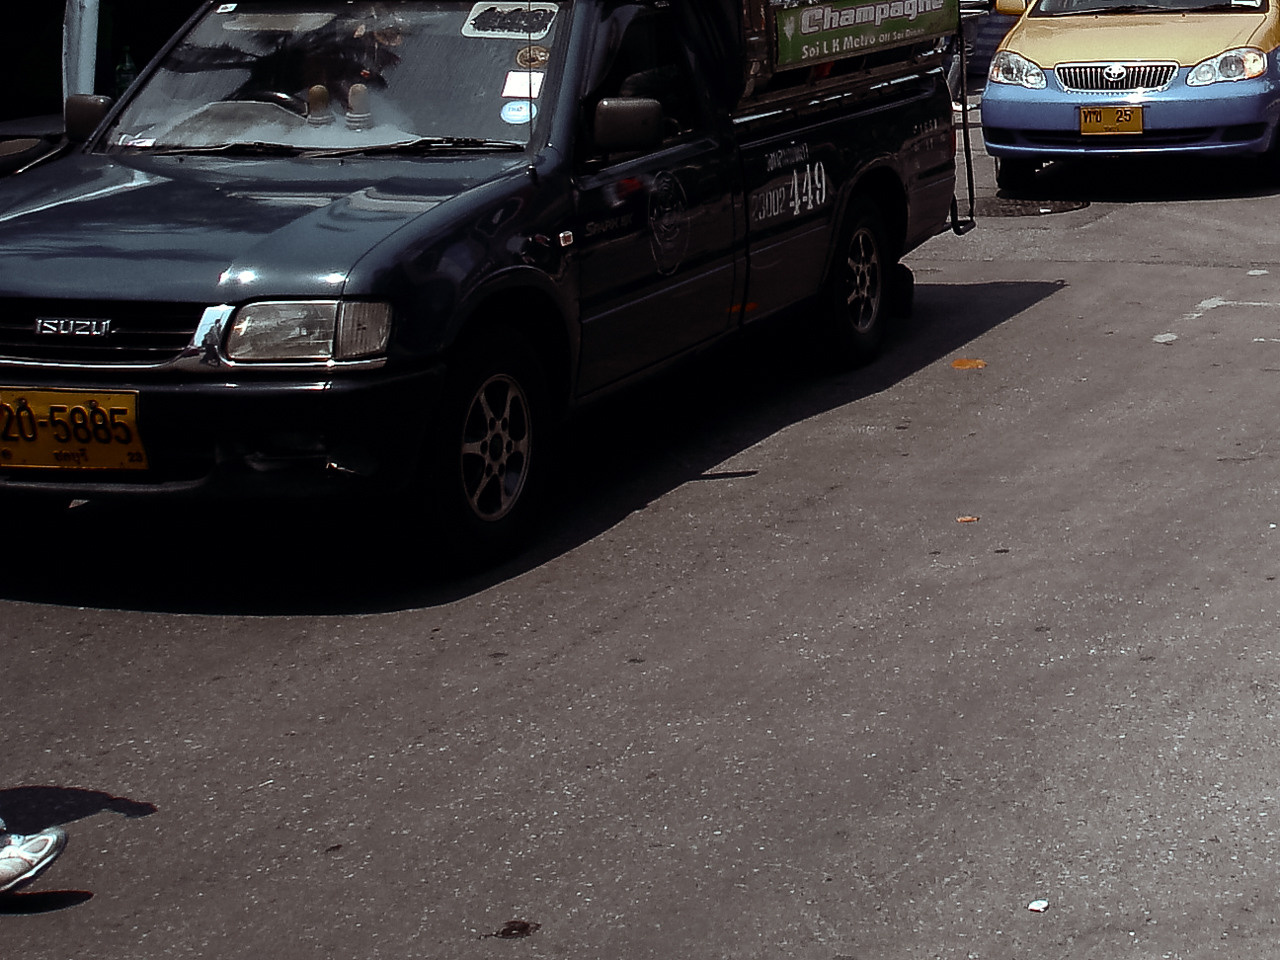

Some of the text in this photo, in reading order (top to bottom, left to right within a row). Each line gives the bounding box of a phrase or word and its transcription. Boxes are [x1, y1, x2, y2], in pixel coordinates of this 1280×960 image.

[801, 41, 820, 60] Soi
[823, 38, 829, 54] L
[832, 35, 840, 53] K
[843, 33, 876, 51] Metro
[1115, 109, 1132, 123] 25
[789, 161, 826, 216] 449
[35, 318, 112, 336] ISUZU
[0, 403, 132, 444] 20-5885
